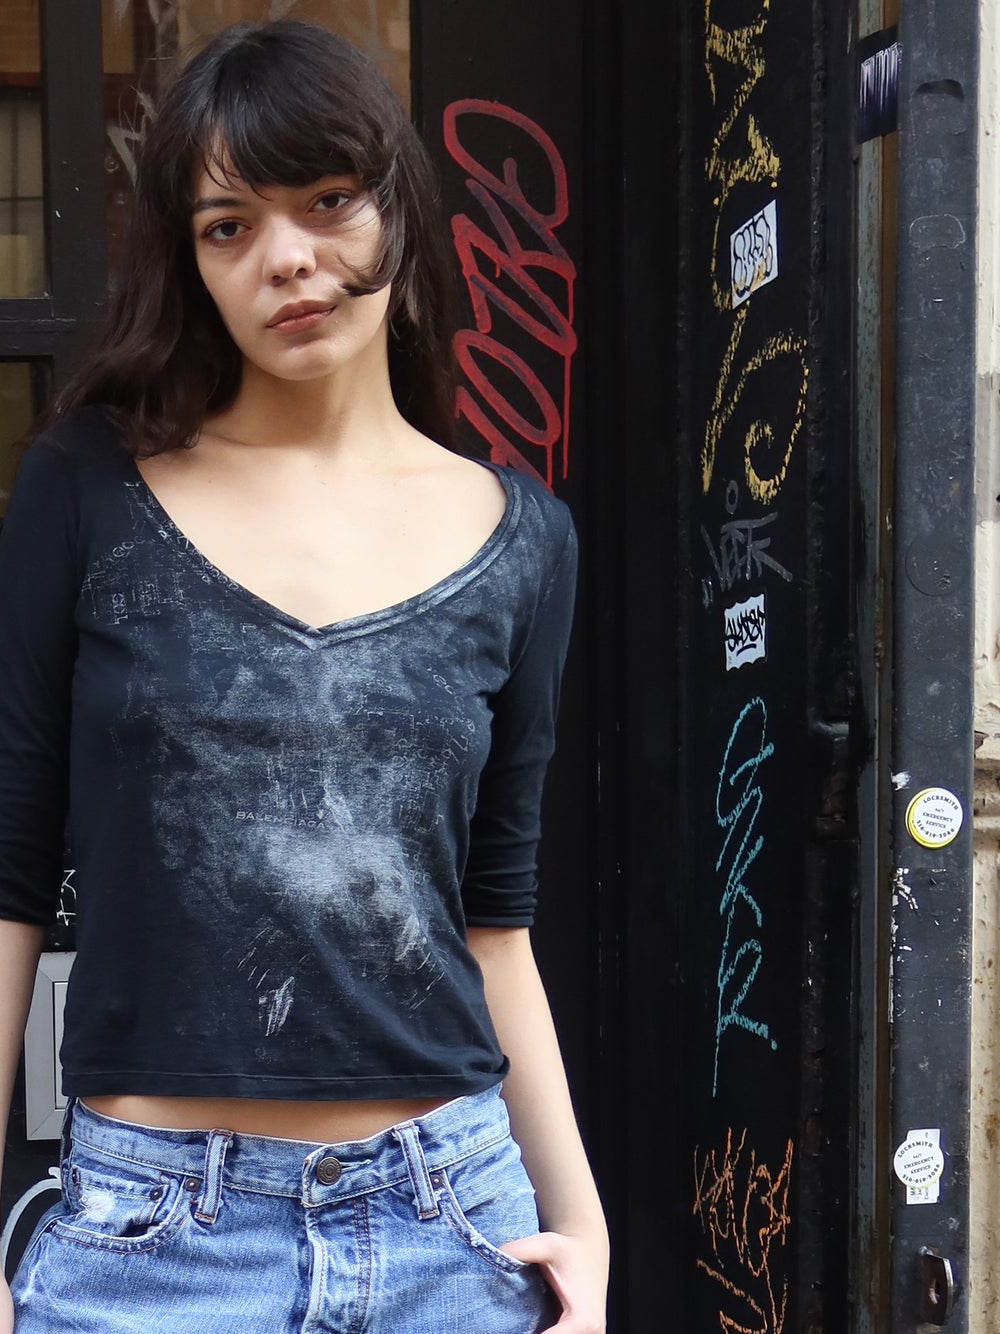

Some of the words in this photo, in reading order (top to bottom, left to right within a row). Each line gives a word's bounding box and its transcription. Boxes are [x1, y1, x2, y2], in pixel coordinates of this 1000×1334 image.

[922, 795, 960, 811] LOCKSMITH
[235, 811, 326, 830] BALENCIAGA
[922, 811, 953, 823] EMERGENCY
[925, 820, 947, 829] SERVICE
[897, 1140, 934, 1159] LOCKSMITH
[903, 1155, 935, 1170] EMERGENCY
[910, 1164, 932, 1175] SERVICE
